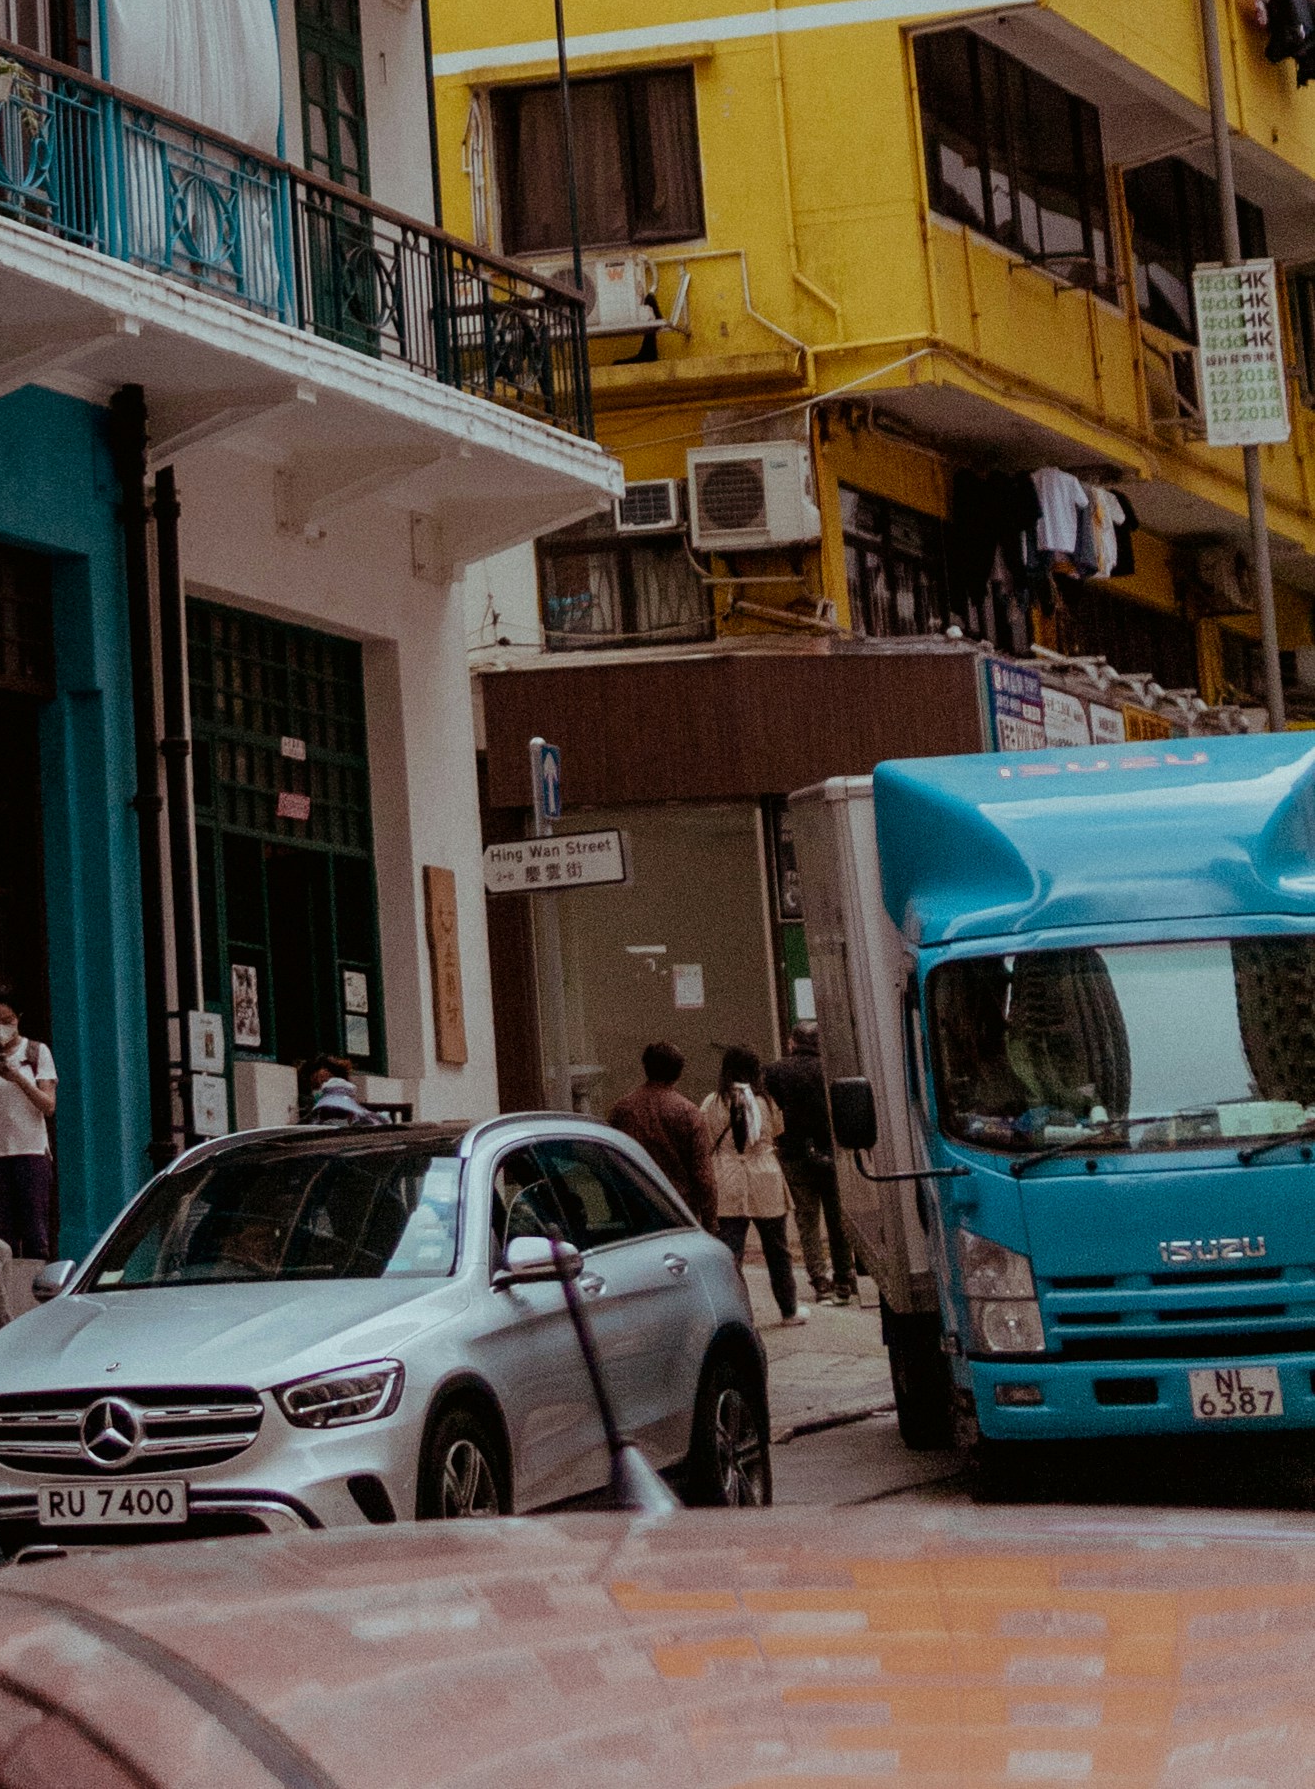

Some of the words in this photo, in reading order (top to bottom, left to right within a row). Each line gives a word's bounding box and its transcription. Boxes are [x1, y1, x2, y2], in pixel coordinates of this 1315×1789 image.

[490, 848, 523, 863] Hing
[529, 845, 560, 858] Wan
[565, 838, 612, 855] Street
[1158, 1235, 1267, 1262] ISUZU
[1214, 1369, 1254, 1393] NL
[1200, 1391, 1274, 1416] 6387
[49, 1489, 85, 1518] RU
[98, 1488, 173, 1517] 7400
